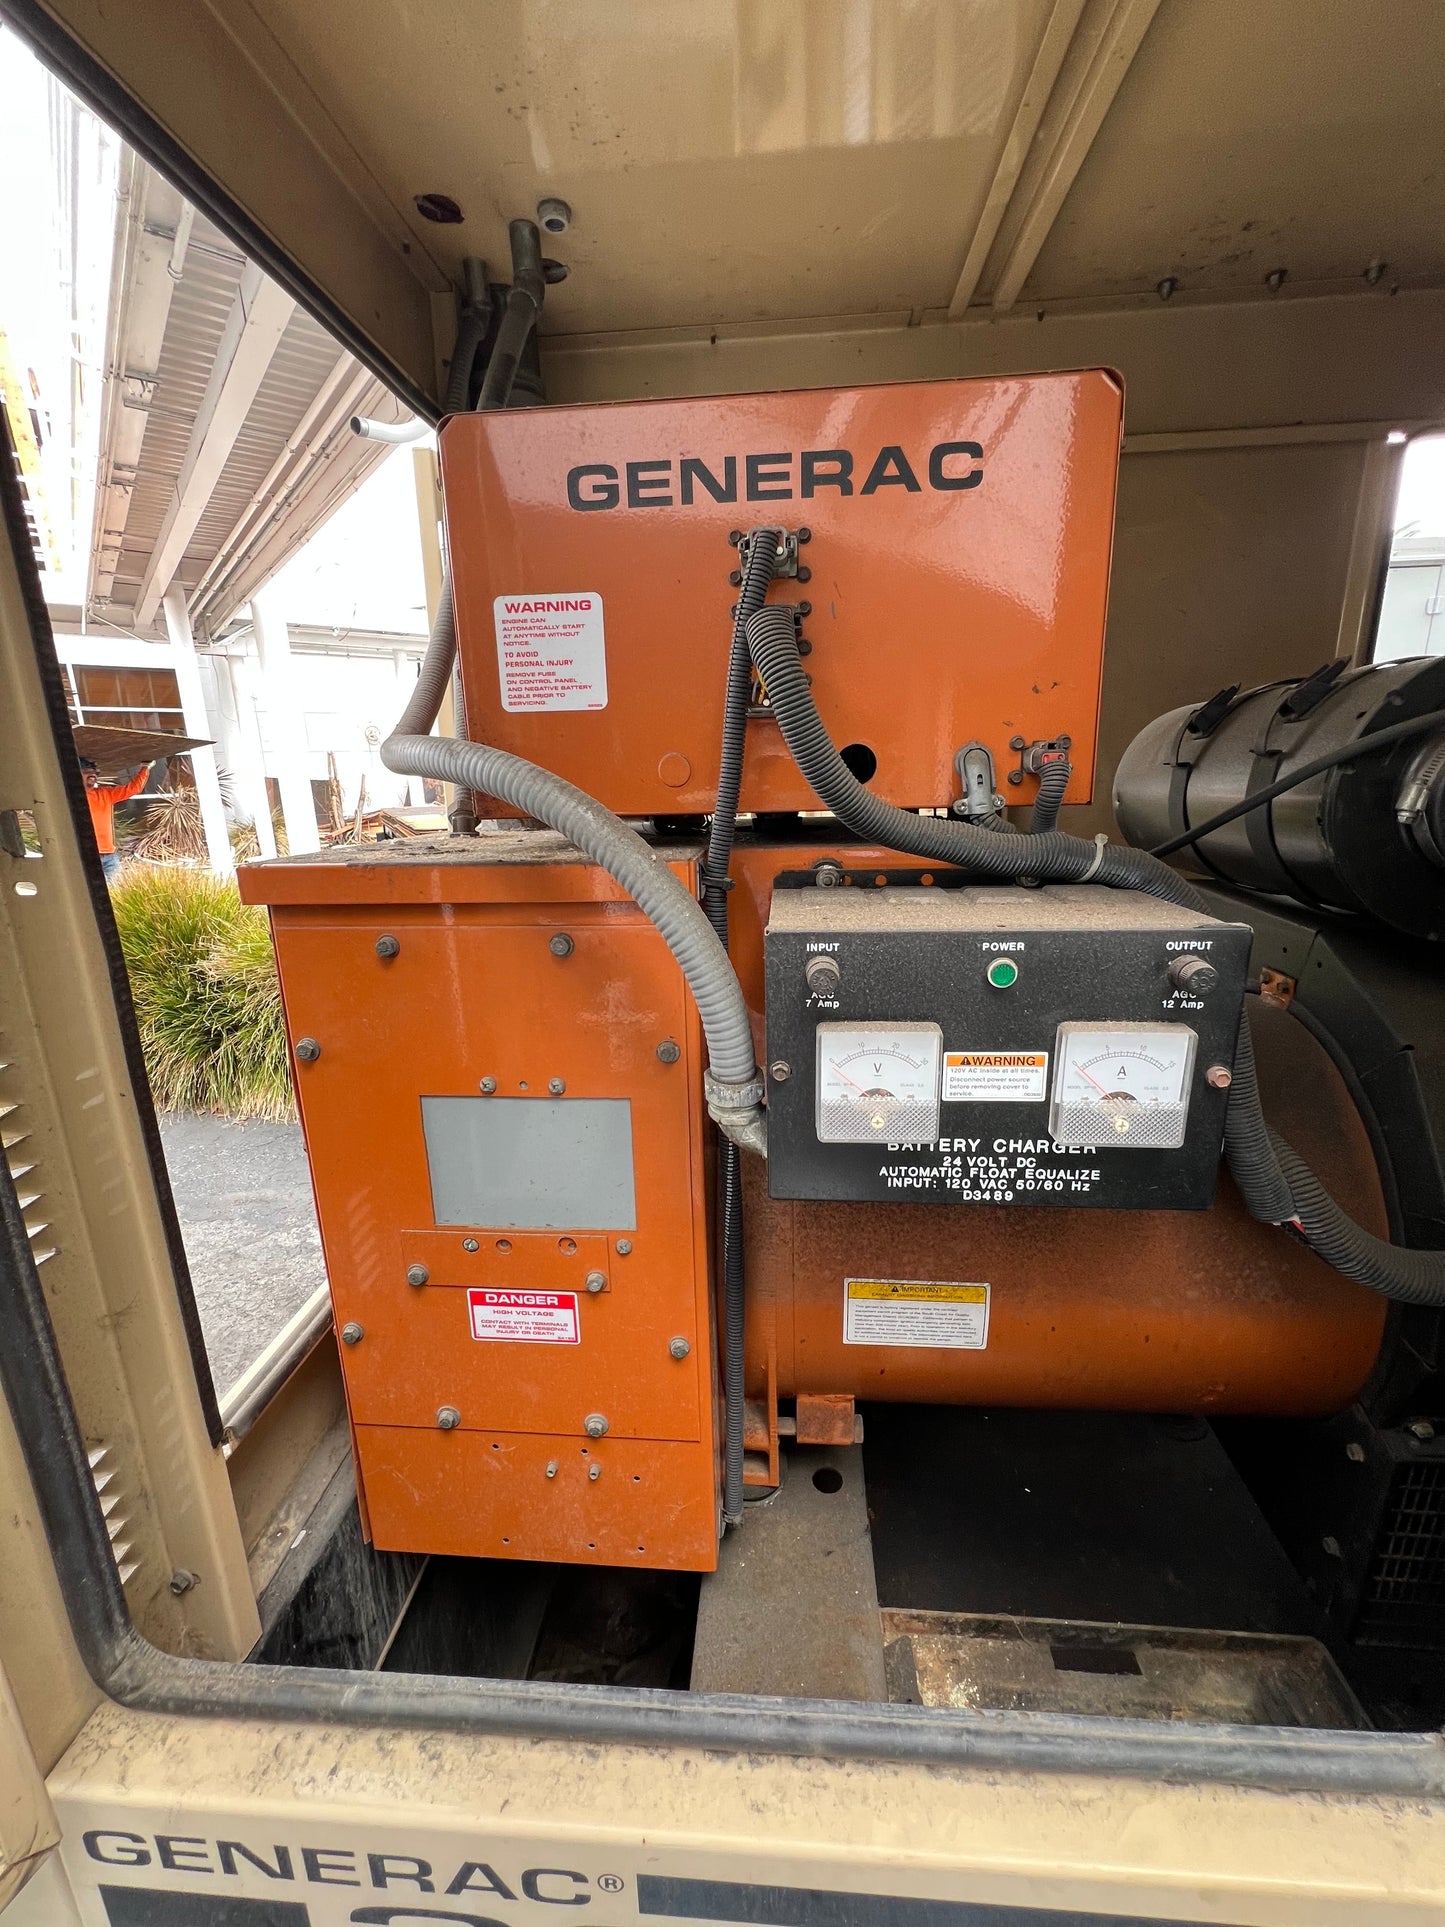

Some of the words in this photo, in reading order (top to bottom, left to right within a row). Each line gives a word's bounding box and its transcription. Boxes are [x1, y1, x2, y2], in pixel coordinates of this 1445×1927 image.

[567, 441, 983, 512] GENERAC
[505, 600, 592, 613] WARNING
[806, 943, 840, 951] INPUT
[982, 942, 1025, 951] POWER
[1166, 941, 1213, 950] OUTPUT
[817, 1000, 840, 1009] Amp
[1162, 1000, 1174, 1008] 12
[1180, 1000, 1204, 1010] Amp
[973, 1057, 1035, 1065] WARNING
[874, 1063, 882, 1073] V
[1117, 1066, 1126, 1076] A
[943, 1157, 962, 1167] 24
[967, 1157, 1008, 1167] VOLT
[1016, 1157, 1037, 1168] DC
[879, 1166, 962, 1177] AUTOMATIC
[970, 1168, 1017, 1179] FLOAT
[1025, 1170, 1100, 1180] EQUALIZE
[887, 1178, 937, 1188] INPUT:
[945, 1179, 971, 1189] 120
[980, 1180, 1008, 1190] VAC
[1016, 1180, 1063, 1190] 50/60
[1071, 1182, 1090, 1192] Hz
[963, 1190, 1013, 1200] D3489
[485, 1294, 558, 1305] DANGER
